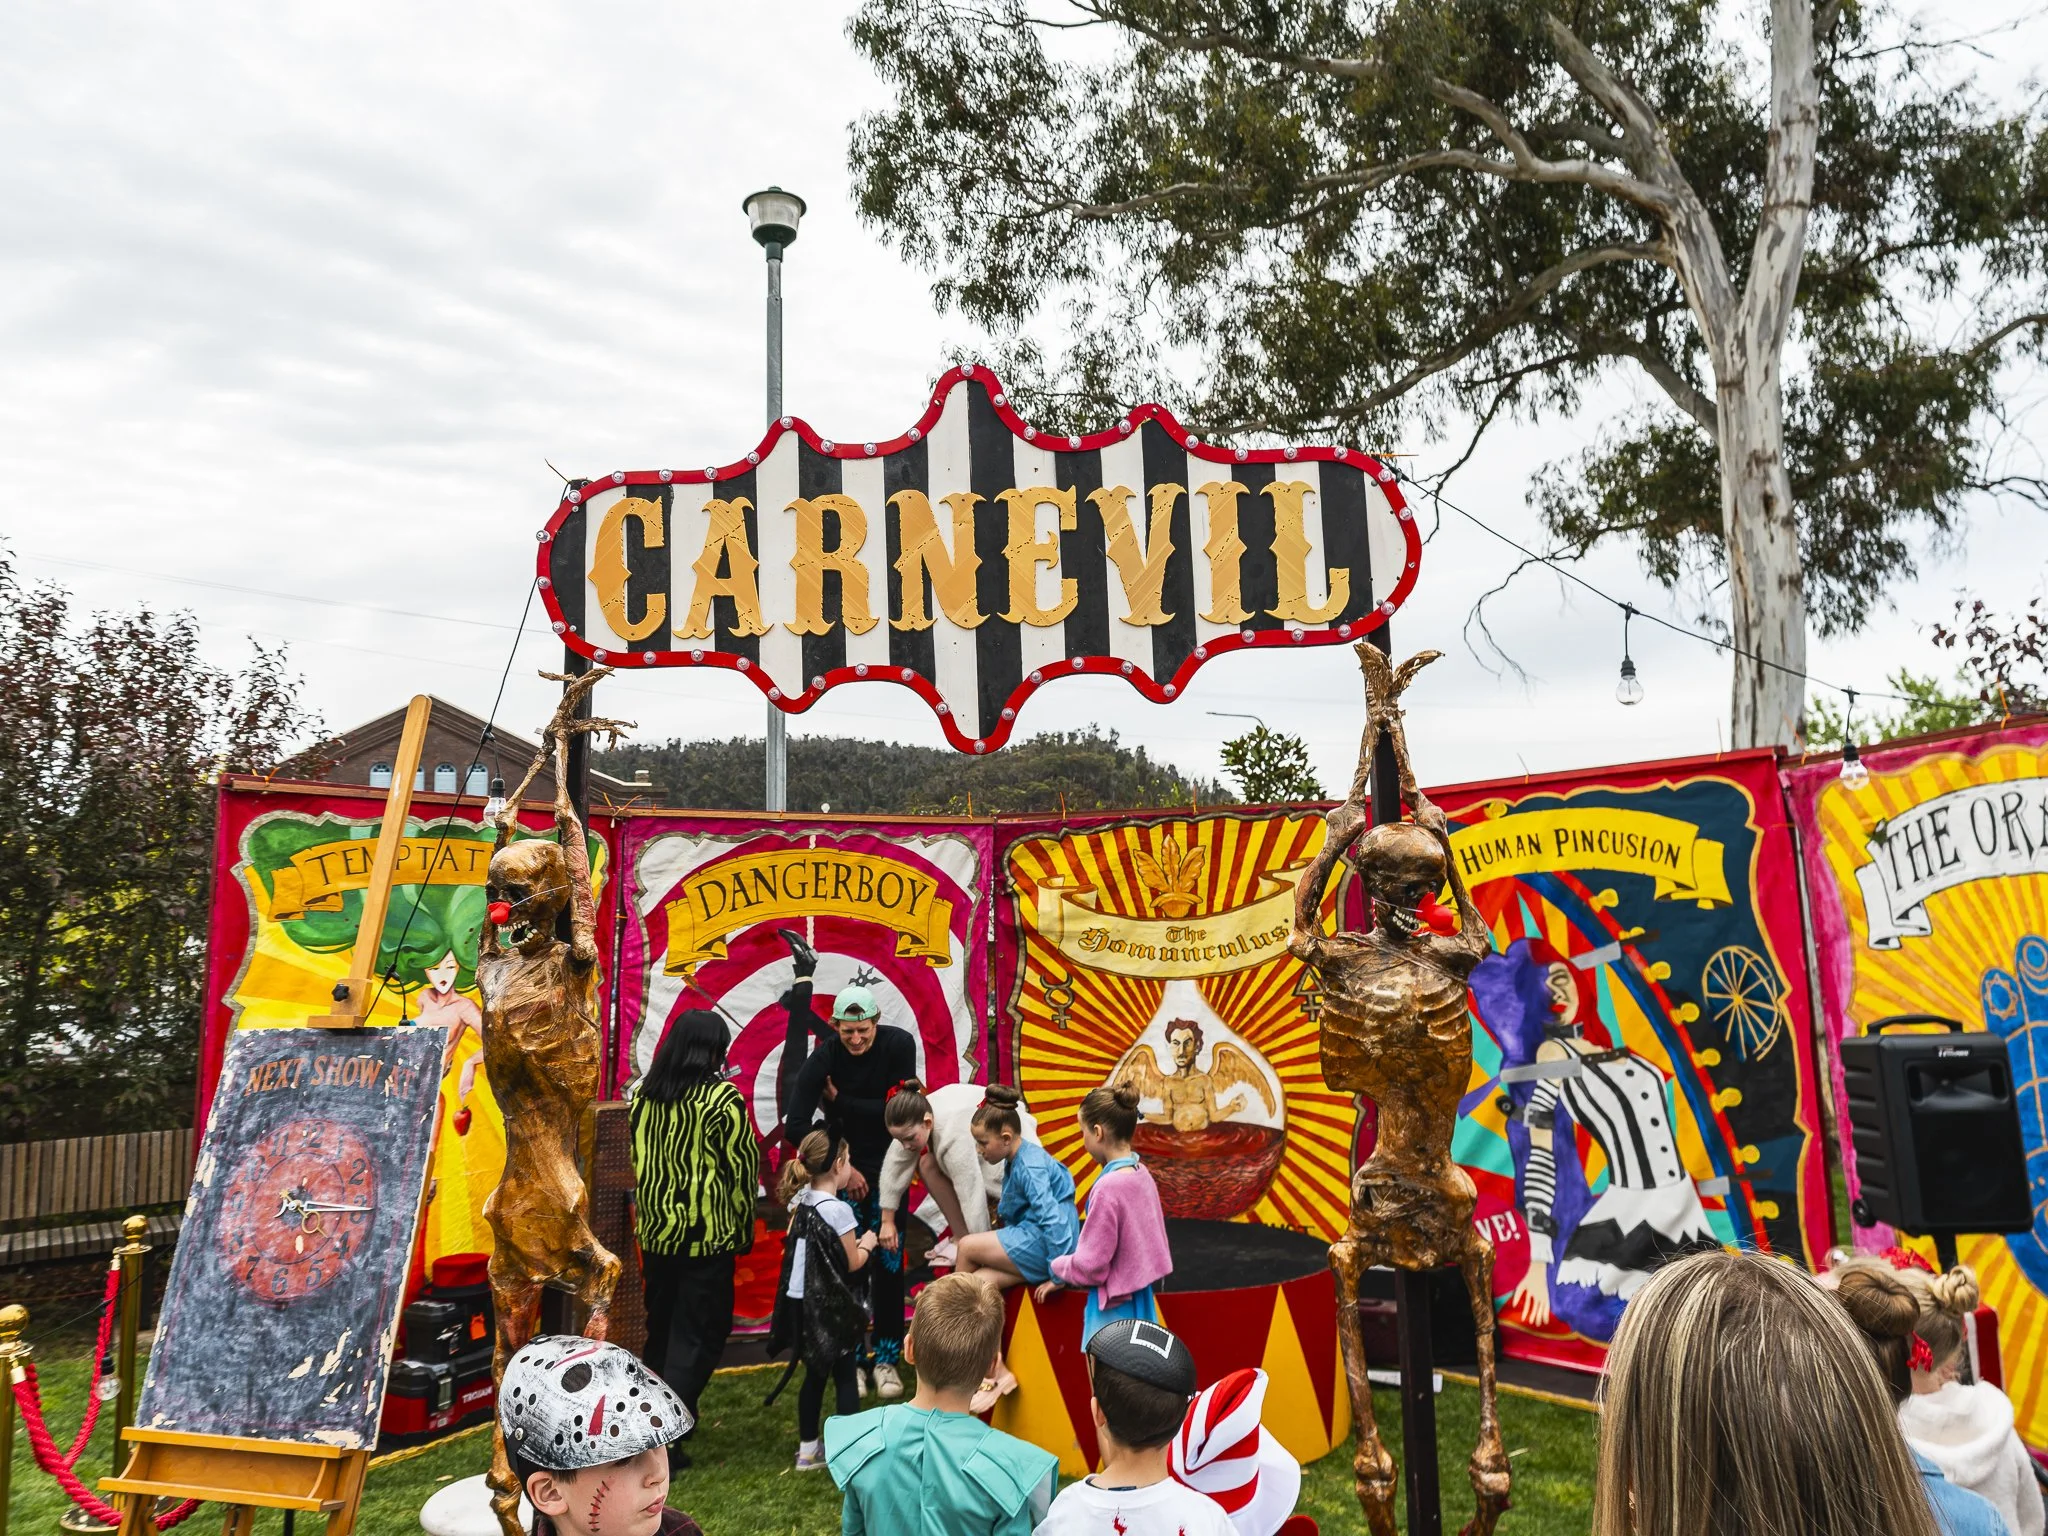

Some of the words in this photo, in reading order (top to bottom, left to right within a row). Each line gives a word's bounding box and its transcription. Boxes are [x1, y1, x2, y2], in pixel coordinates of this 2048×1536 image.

[586, 481, 1351, 641] CARNEVIL
[1460, 833, 1542, 875] HUMAN
[1554, 828, 1681, 869] PINCUSION
[1887, 806, 1960, 891] THE
[305, 845, 494, 886] TEPTAT
[694, 859, 930, 922] DANGERBOY
[1166, 926, 1207, 944] The
[244, 1058, 306, 1096] NEXT
[310, 1055, 383, 1089] SHOW
[384, 1065, 416, 1099] AT
[271, 1132, 289, 1157] 11
[301, 1122, 325, 1148] 12
[348, 1158, 366, 1185] 2
[350, 1195, 367, 1224] 3
[1474, 1210, 1521, 1242] VE!
[333, 1231, 349, 1260] 4
[245, 1256, 260, 1280] 7
[271, 1267, 288, 1295] 6
[305, 1259, 324, 1287] 5
